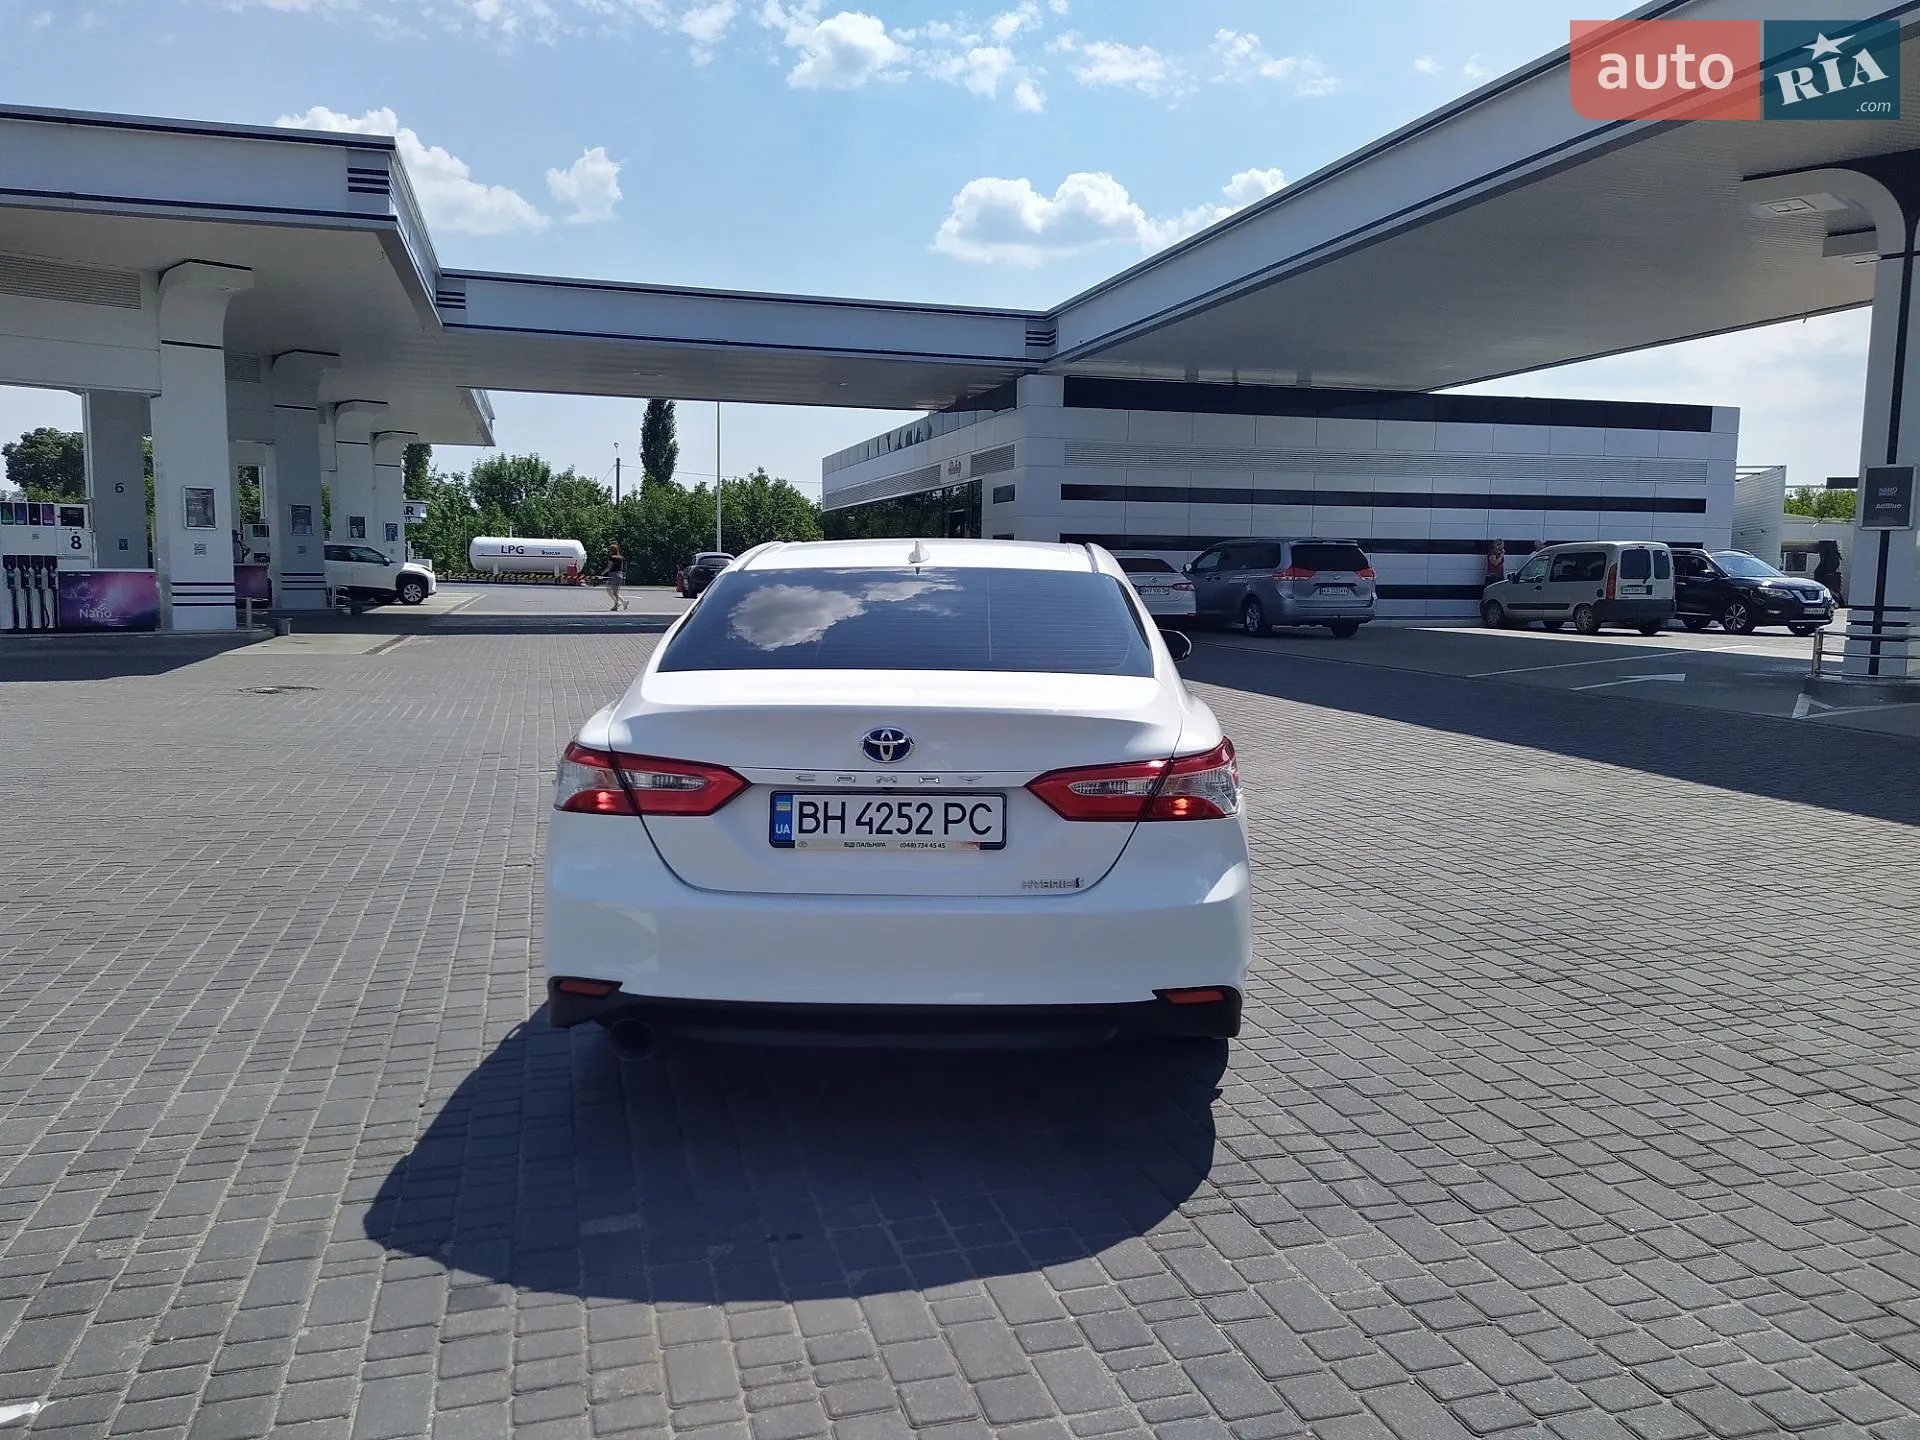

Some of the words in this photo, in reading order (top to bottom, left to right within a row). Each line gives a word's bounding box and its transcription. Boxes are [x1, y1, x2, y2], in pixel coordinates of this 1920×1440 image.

[114, 482, 125, 493] 6
[70, 535, 82, 550] 8
[501, 545, 525, 554] LPG
[79, 608, 112, 618] Nano
[795, 773, 983, 784] CAMRY
[798, 801, 846, 834] BH
[855, 802, 934, 835] 4252
[944, 802, 992, 835] PC
[775, 824, 790, 834] UA
